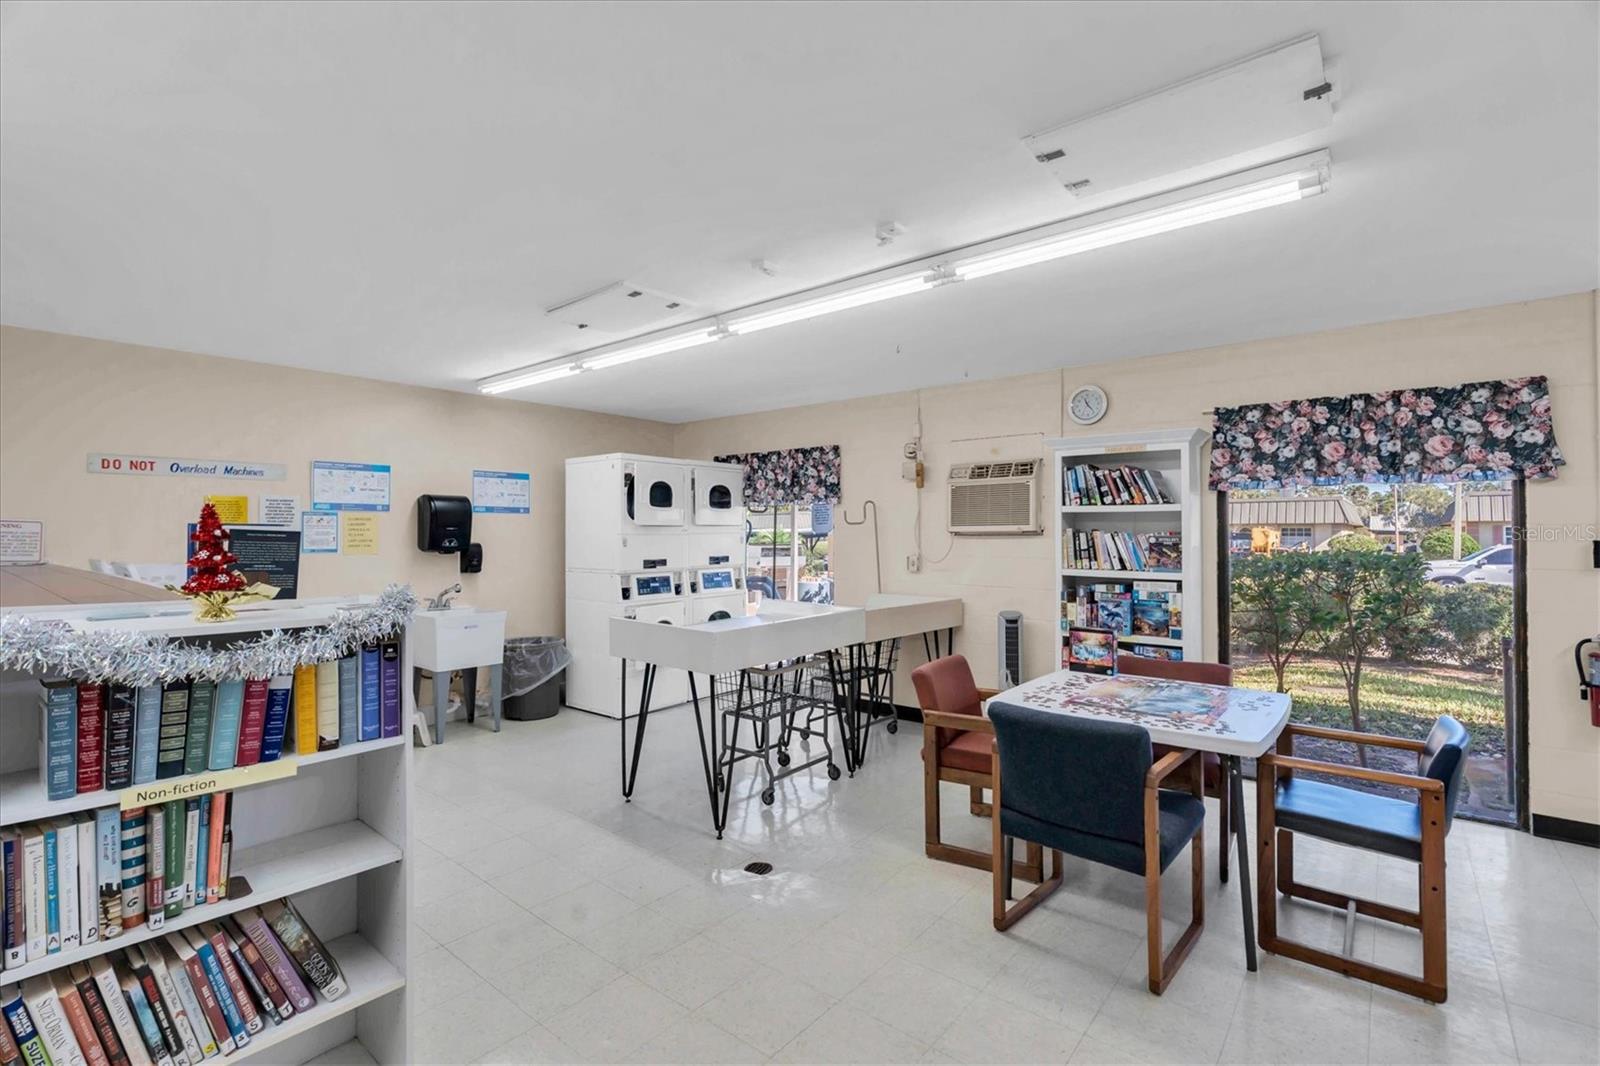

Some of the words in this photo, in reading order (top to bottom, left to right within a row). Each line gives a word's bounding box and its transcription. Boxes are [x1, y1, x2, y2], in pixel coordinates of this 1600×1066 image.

[101, 458, 122, 470] DO
[129, 460, 156, 472] NOT
[170, 462, 218, 474] Overload
[224, 465, 264, 476] Machines
[136, 780, 216, 802] Non-fiction
[86, 926, 98, 938] D
[11, 951, 18, 960] B
[36, 997, 56, 1022] SUZE
[44, 1016, 66, 1050] ORMAN
[250, 1021, 258, 1031] S
[26, 1042, 46, 1066] SUZE
